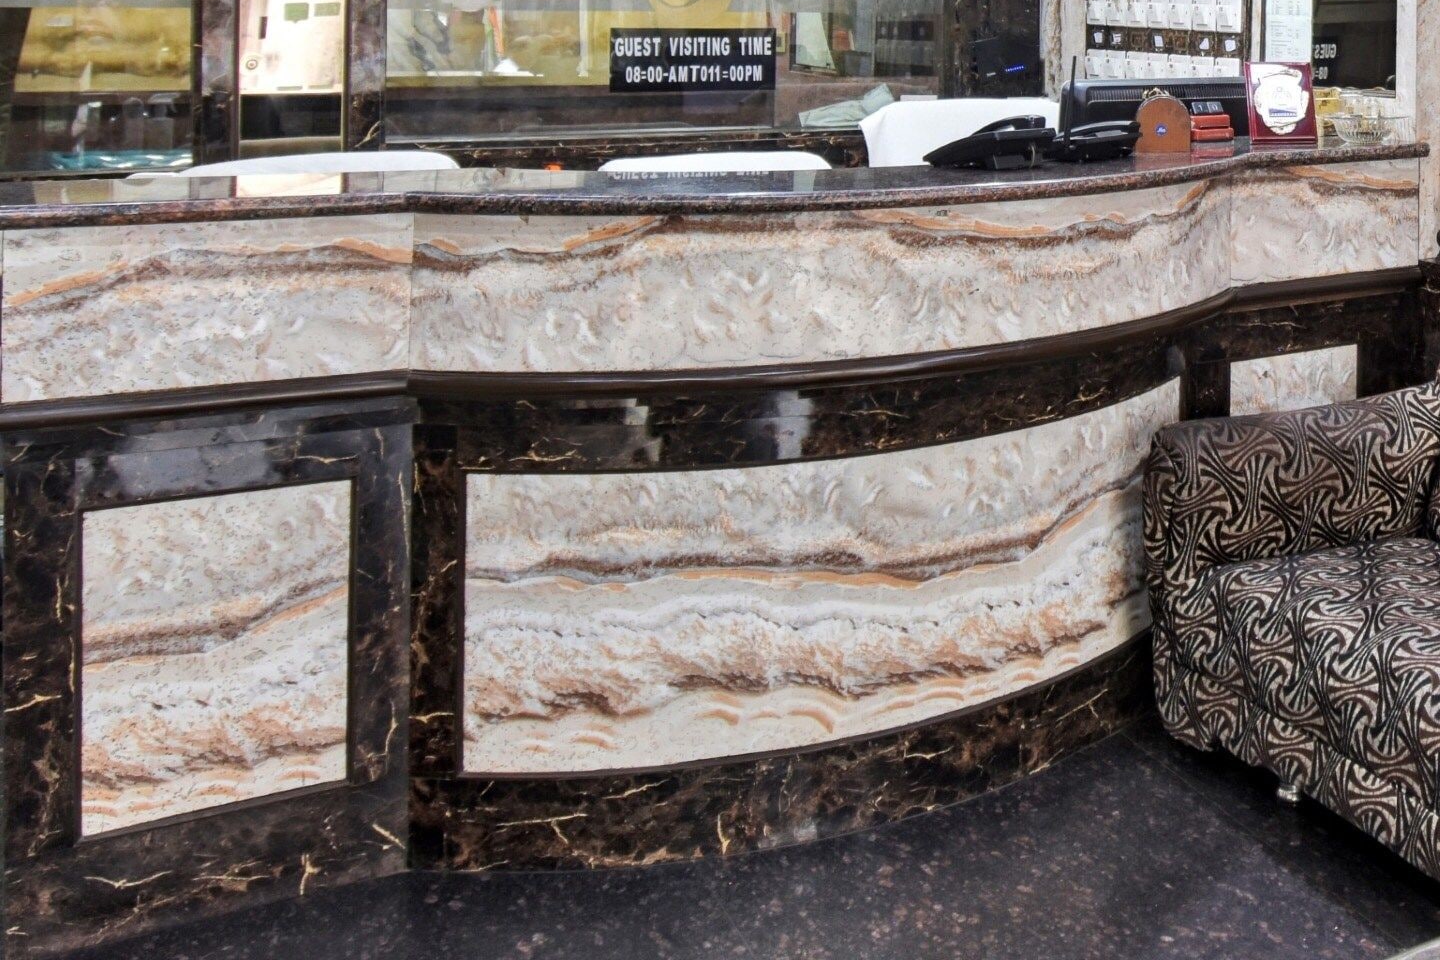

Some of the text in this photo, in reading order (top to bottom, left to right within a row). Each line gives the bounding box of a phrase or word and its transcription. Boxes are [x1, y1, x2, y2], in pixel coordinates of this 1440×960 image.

[614, 36, 773, 57] GUEST VISITING TIME
